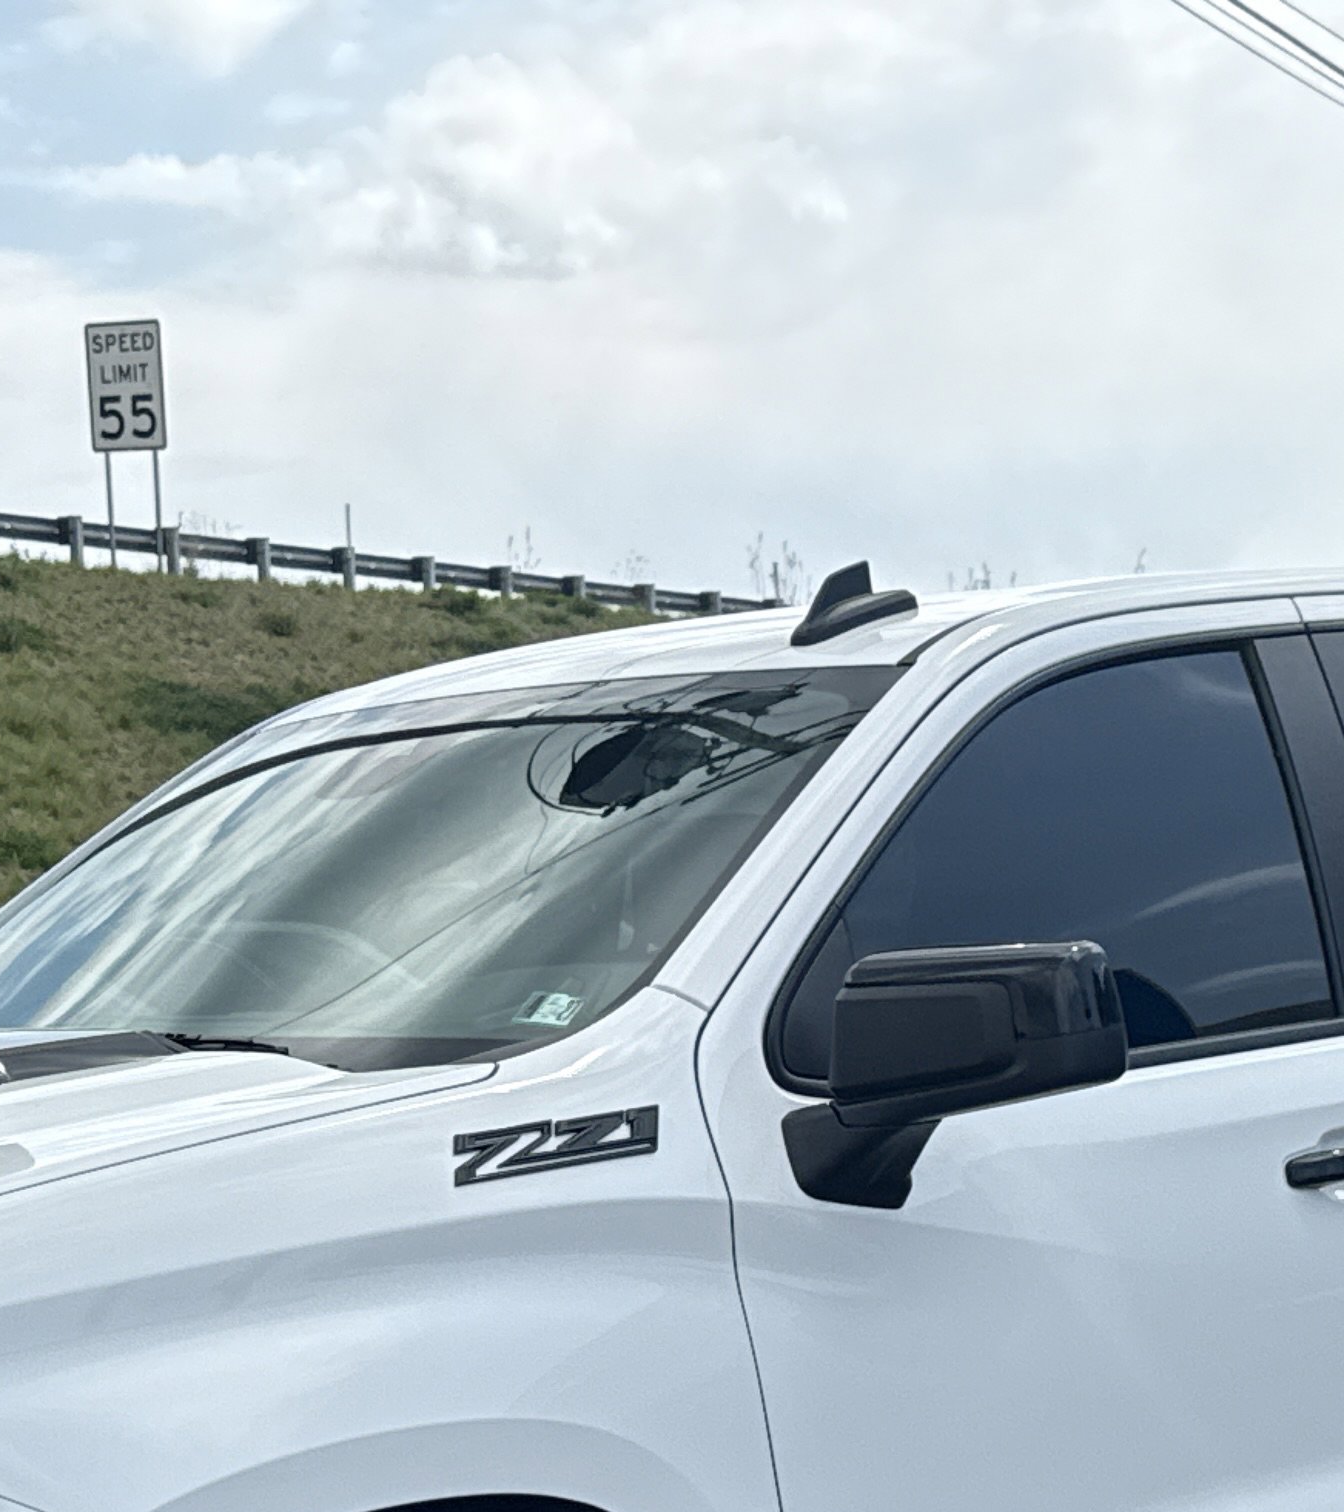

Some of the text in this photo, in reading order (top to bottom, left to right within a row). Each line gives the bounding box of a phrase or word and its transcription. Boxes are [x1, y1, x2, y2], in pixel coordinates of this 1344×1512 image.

[92, 331, 154, 354] SPEED
[100, 363, 149, 384] LIMIT
[99, 393, 157, 440] 55
[453, 1104, 659, 1188] Z71
